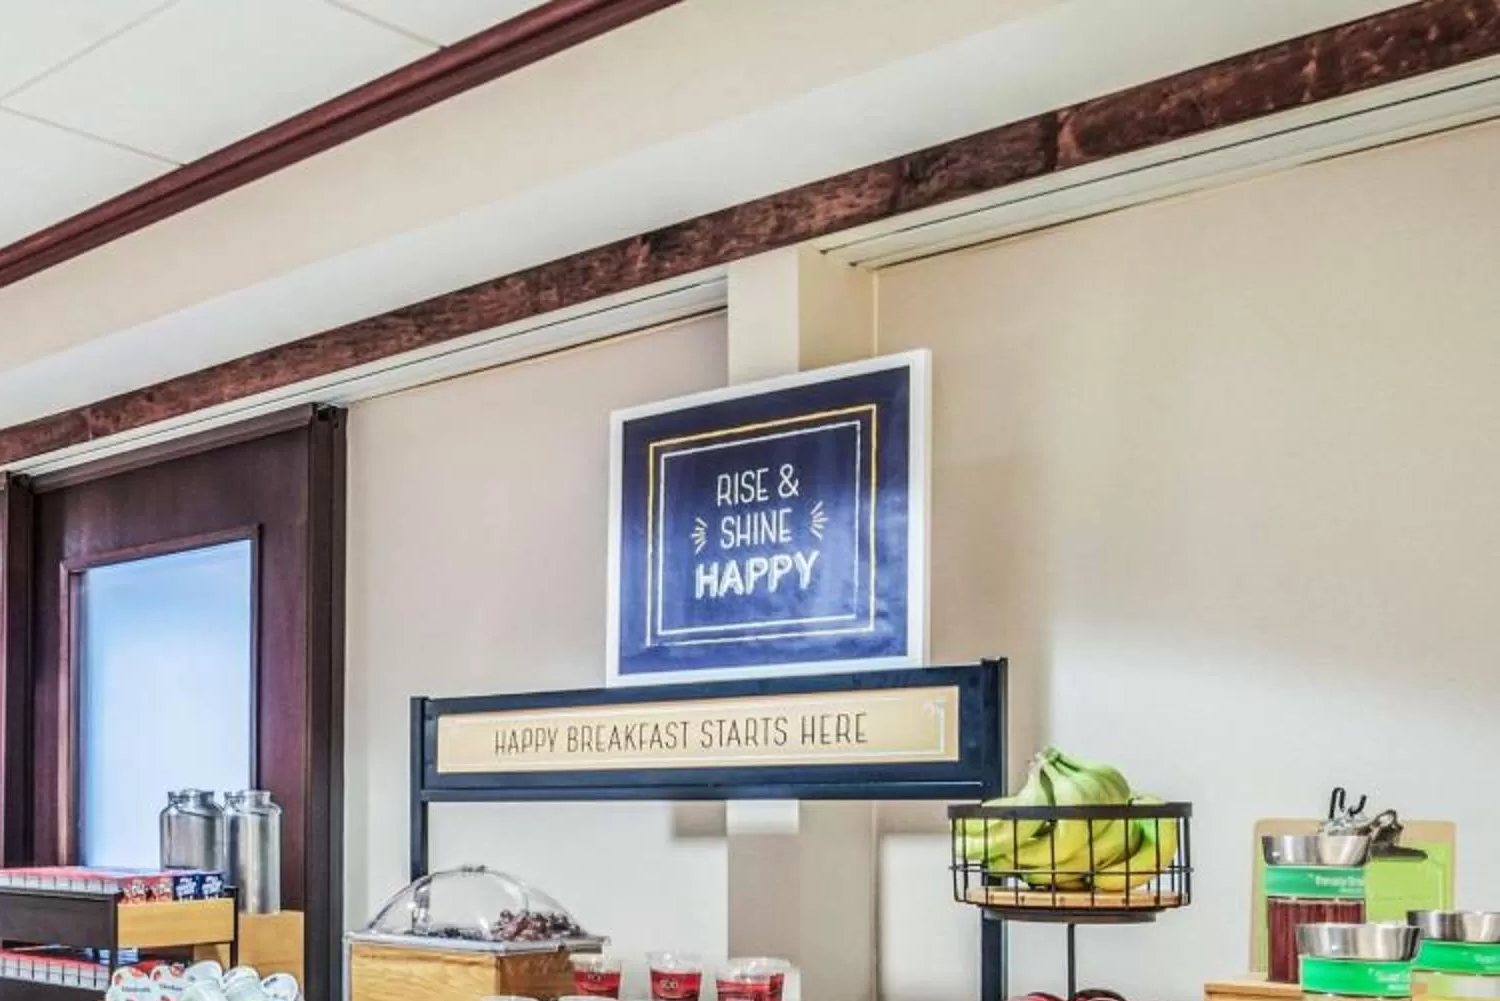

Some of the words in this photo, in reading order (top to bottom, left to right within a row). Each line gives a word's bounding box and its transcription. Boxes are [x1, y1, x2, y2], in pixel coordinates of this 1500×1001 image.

[716, 468, 769, 507] RISE
[778, 464, 800, 498] &
[719, 508, 793, 550] SHINE
[694, 550, 820, 600] HAPPY
[495, 726, 558, 756] HAPPY
[567, 721, 690, 754] BREAKFAST
[701, 716, 788, 749] STARTS
[801, 713, 868, 745] HERE
